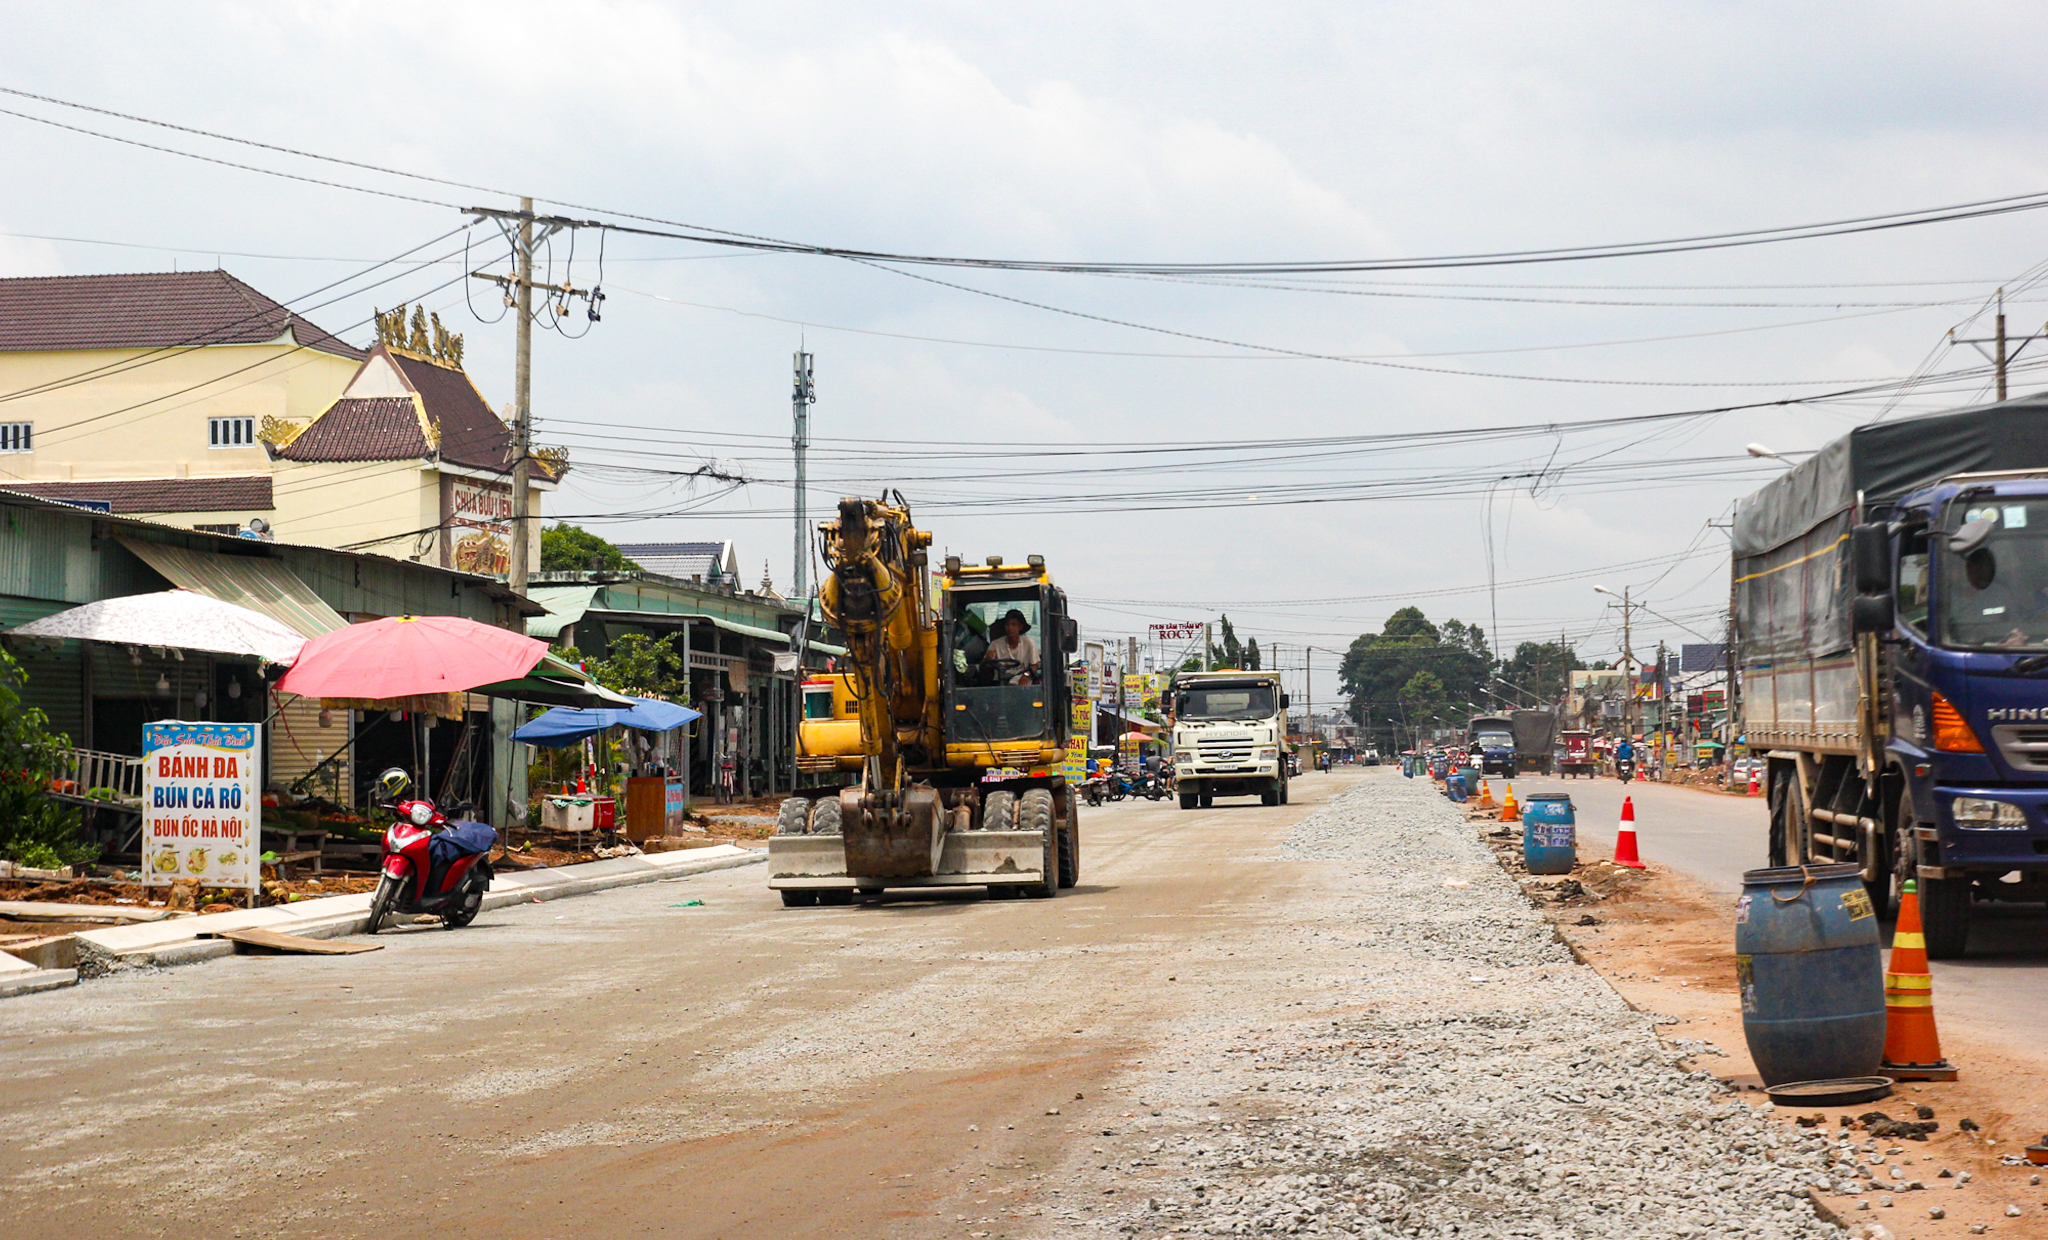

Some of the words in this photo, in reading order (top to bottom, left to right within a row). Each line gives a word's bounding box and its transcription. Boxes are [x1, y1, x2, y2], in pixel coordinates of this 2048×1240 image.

[455, 487, 478, 514] CHÙA
[1158, 630, 1194, 640] ROCY
[173, 732, 196, 748] Sản
[196, 733, 222, 747] Thái
[223, 733, 246, 747] Bình
[158, 751, 209, 779] BÁNH
[213, 756, 238, 779] ĐA
[153, 781, 188, 809] BÚN
[192, 782, 215, 809] CÁ
[219, 782, 242, 810] RÔ
[153, 815, 179, 838] BÚN
[182, 814, 199, 838] ỐC
[201, 815, 218, 838] HÀ
[221, 816, 242, 842] NỘI
